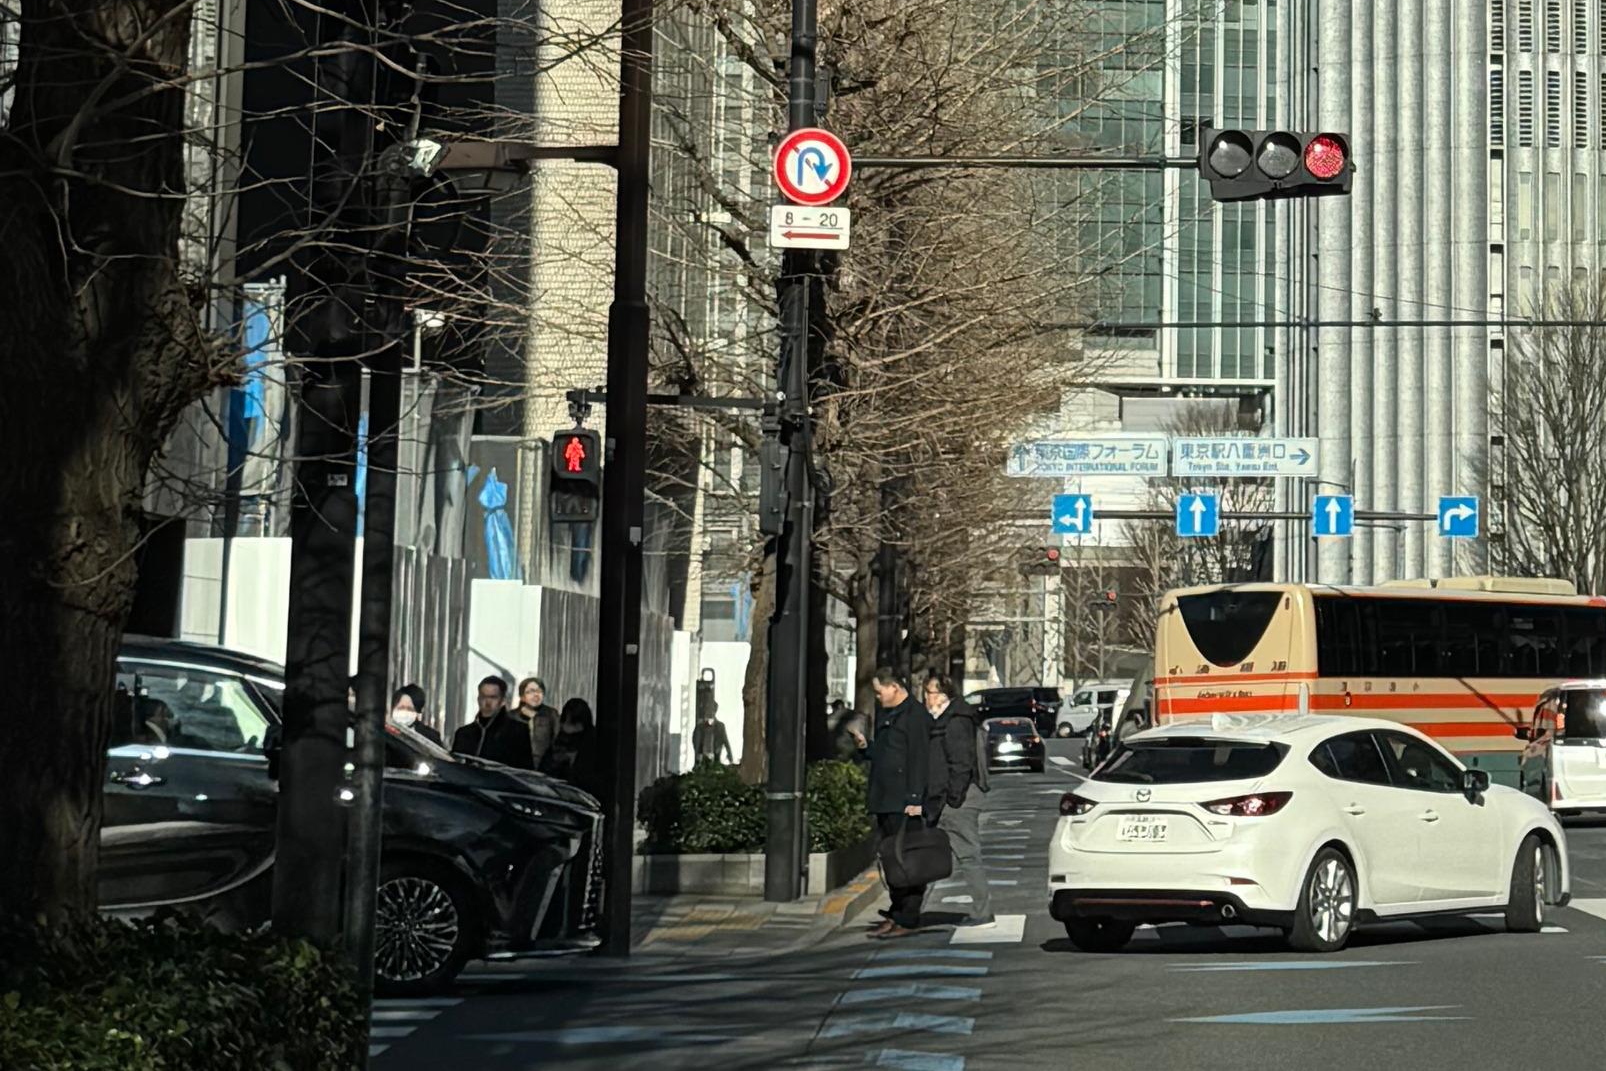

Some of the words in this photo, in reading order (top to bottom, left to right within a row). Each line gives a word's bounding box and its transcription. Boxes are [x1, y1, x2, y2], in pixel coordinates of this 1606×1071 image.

[820, 213, 838, 227] 20
[1034, 442, 1159, 460] 東京国際フォーラム
[1180, 442, 1286, 460] 東京駅八重洲口
[1066, 462, 1126, 472] INTERNATIONAL
[1131, 462, 1159, 472] FORUM
[1188, 462, 1213, 472] Tokyo
